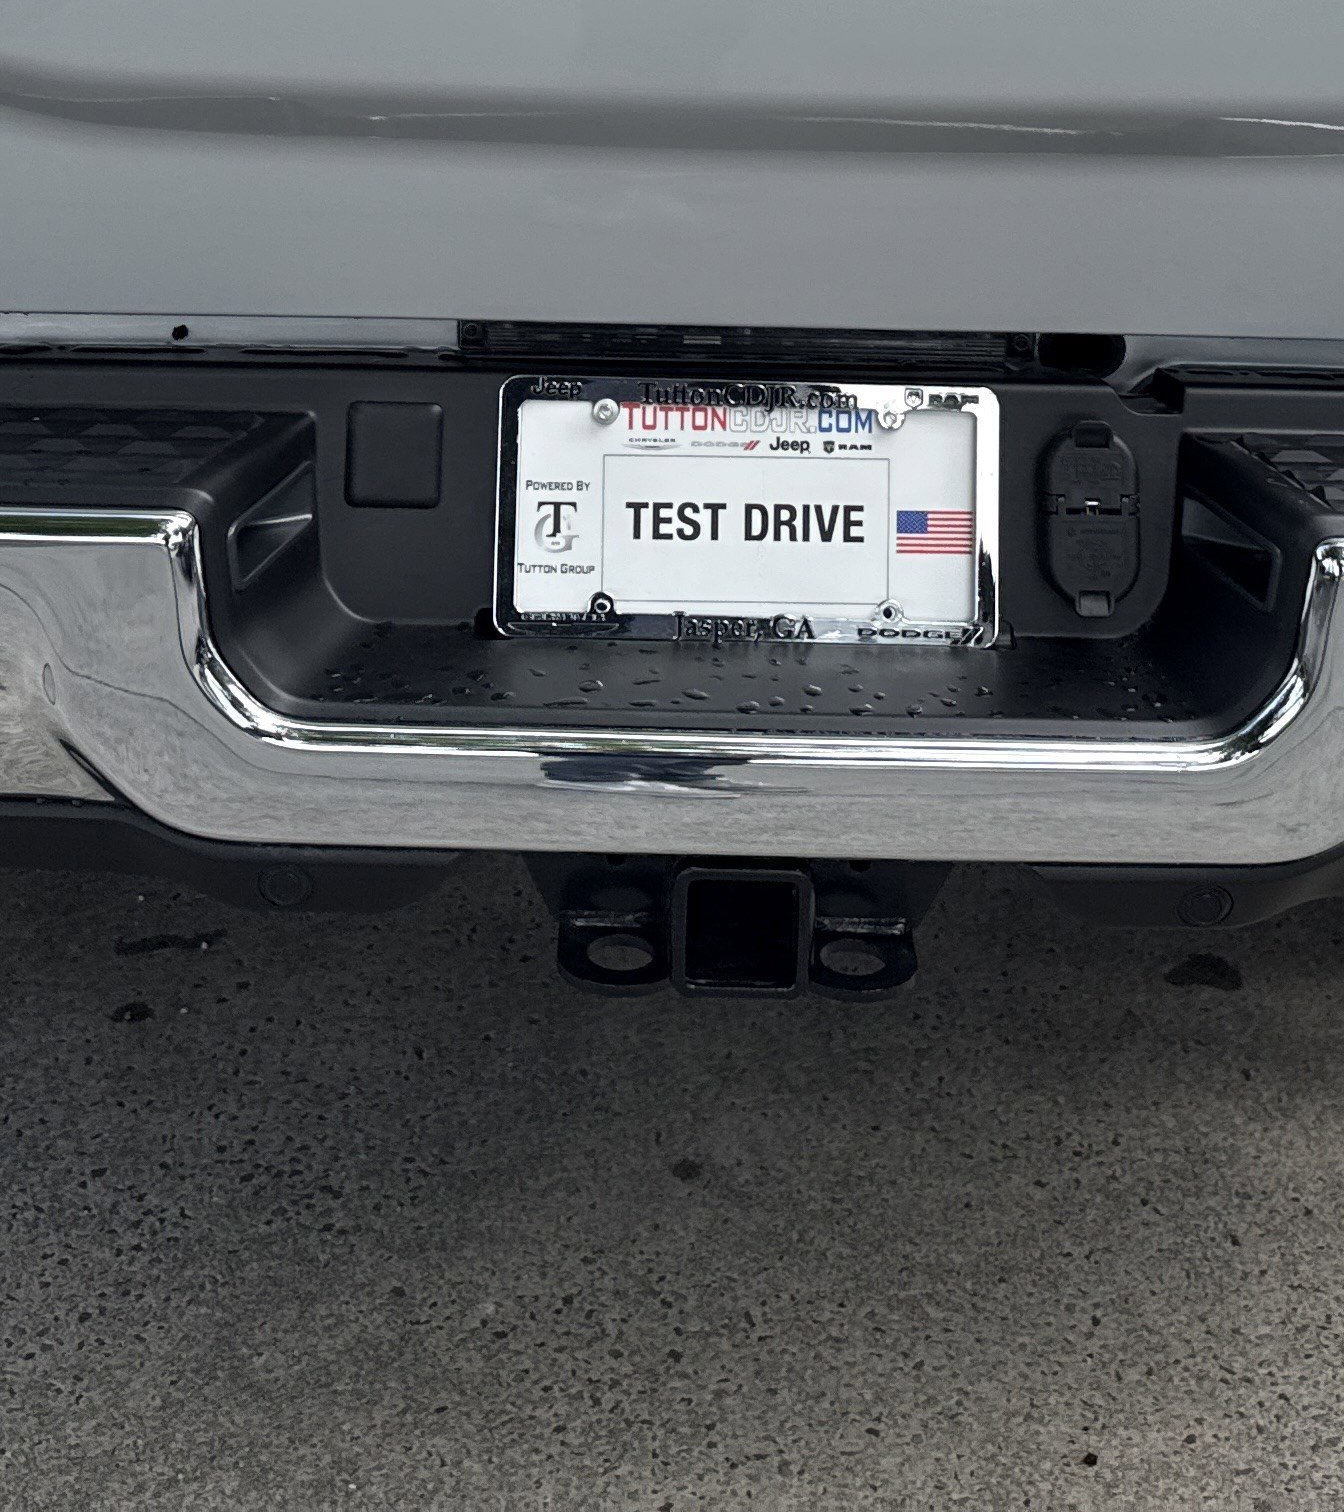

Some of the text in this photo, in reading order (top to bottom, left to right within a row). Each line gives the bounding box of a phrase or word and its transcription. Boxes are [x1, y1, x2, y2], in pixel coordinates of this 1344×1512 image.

[531, 376, 583, 399] Jeep
[769, 436, 811, 454] Jeep
[838, 443, 872, 451] RAM
[625, 501, 865, 543] TEST DRIVE
[560, 563, 596, 575] GROUP
[771, 614, 817, 640] GA
